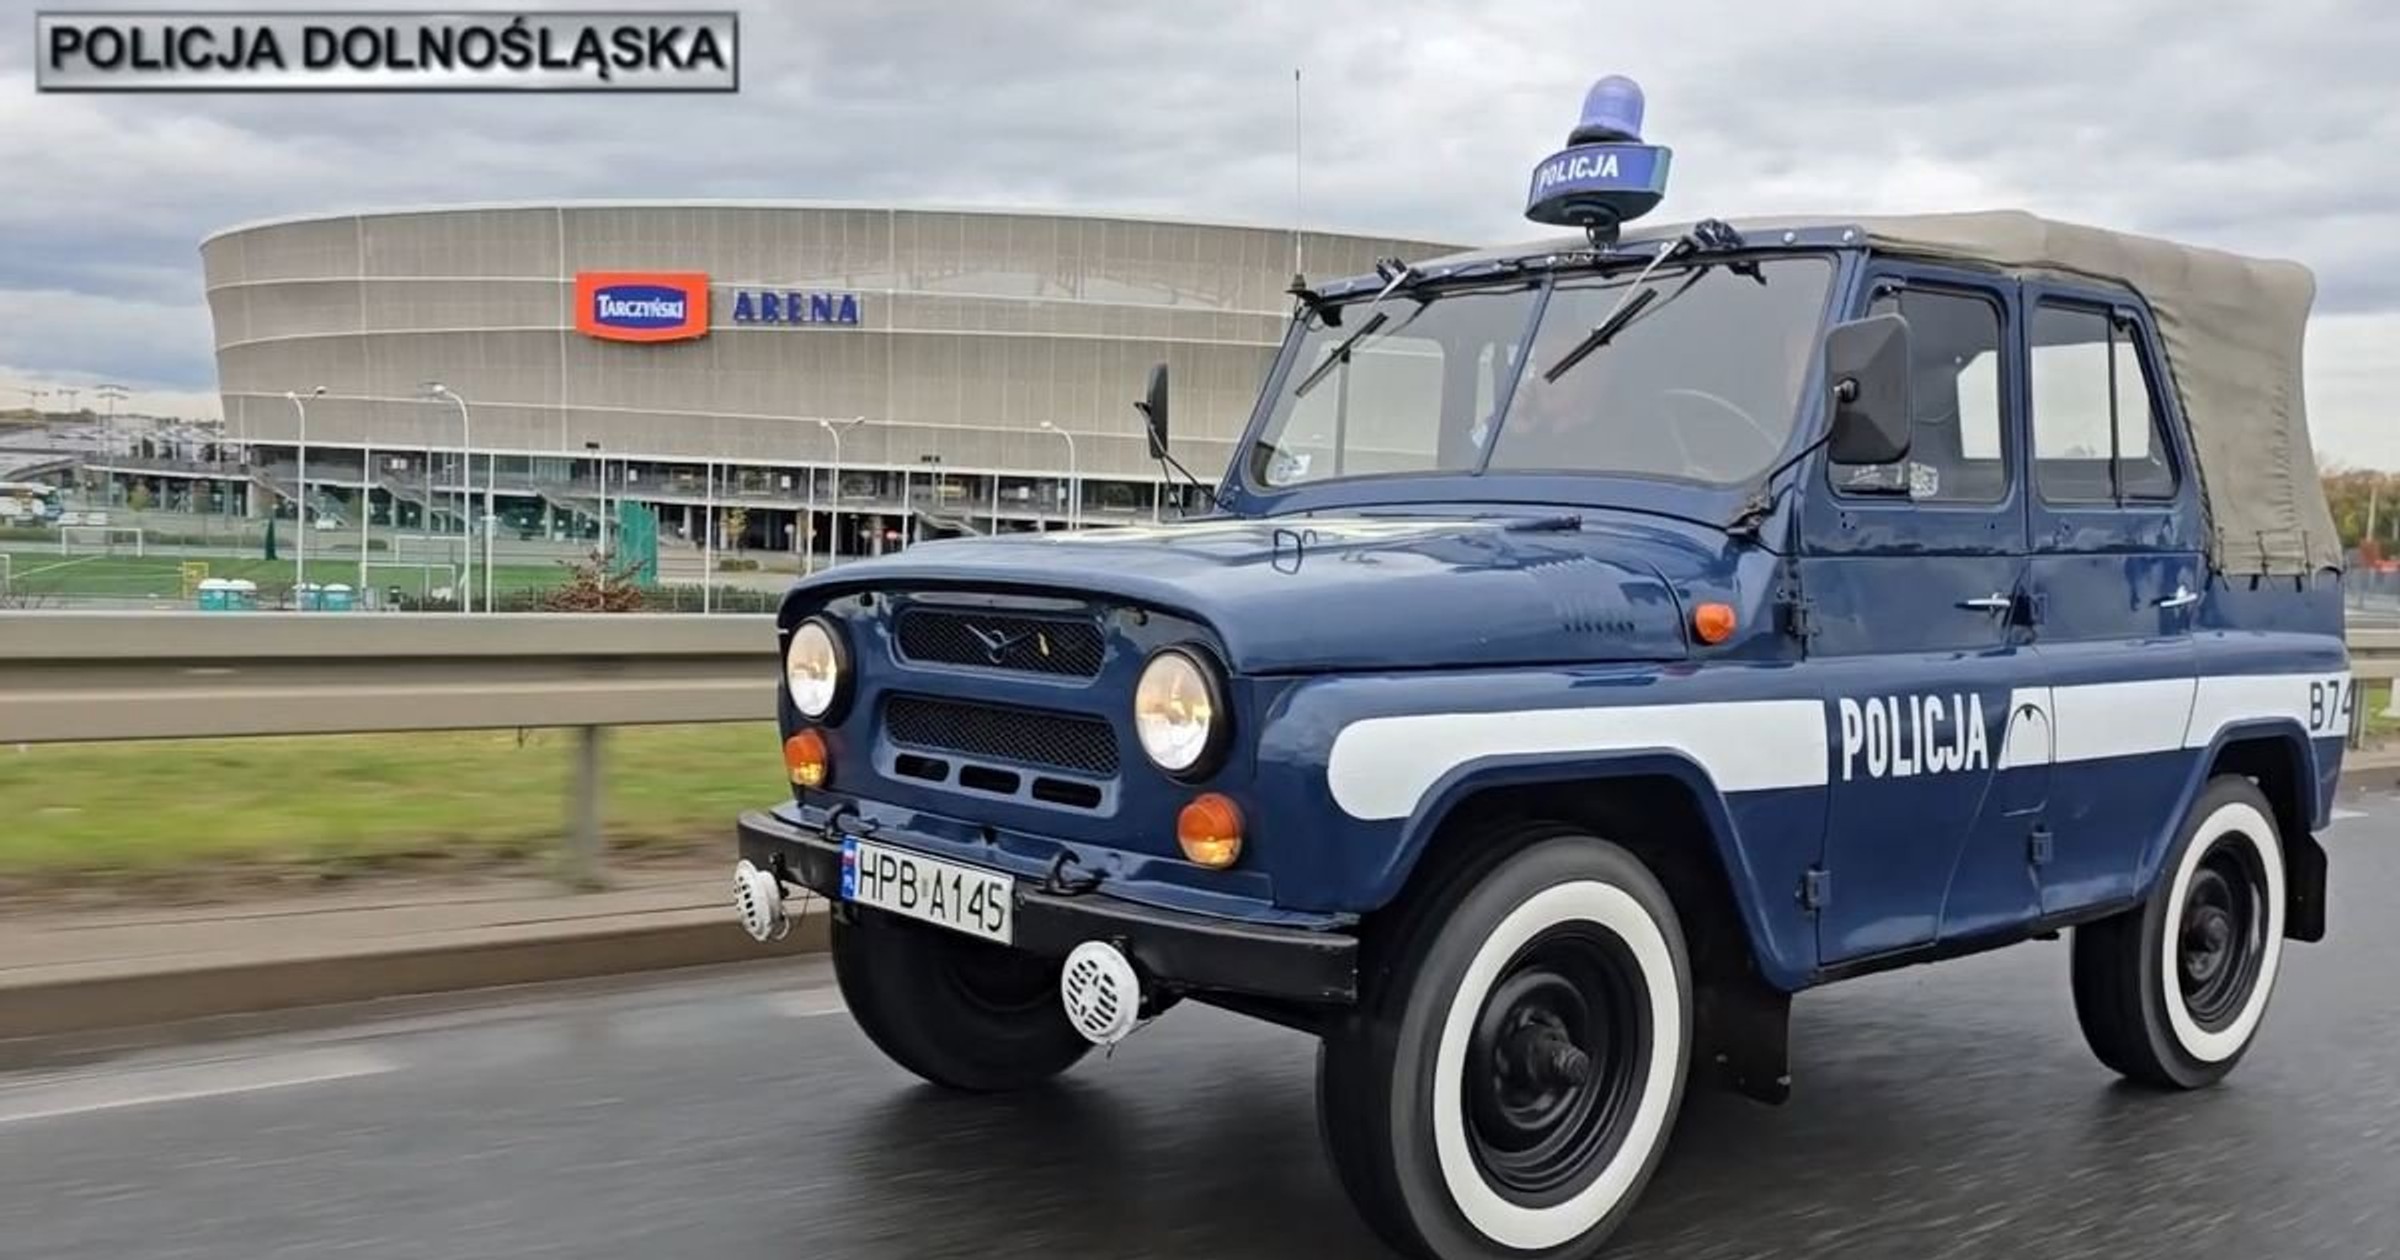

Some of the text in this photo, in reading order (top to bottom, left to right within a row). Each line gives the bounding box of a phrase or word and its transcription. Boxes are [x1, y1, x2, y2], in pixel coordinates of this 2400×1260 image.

[1538, 154, 1619, 193] POLICJA
[733, 291, 859, 325] ARENA
[1840, 693, 1989, 780] POLICJA
[859, 849, 1006, 932] HPB A145
